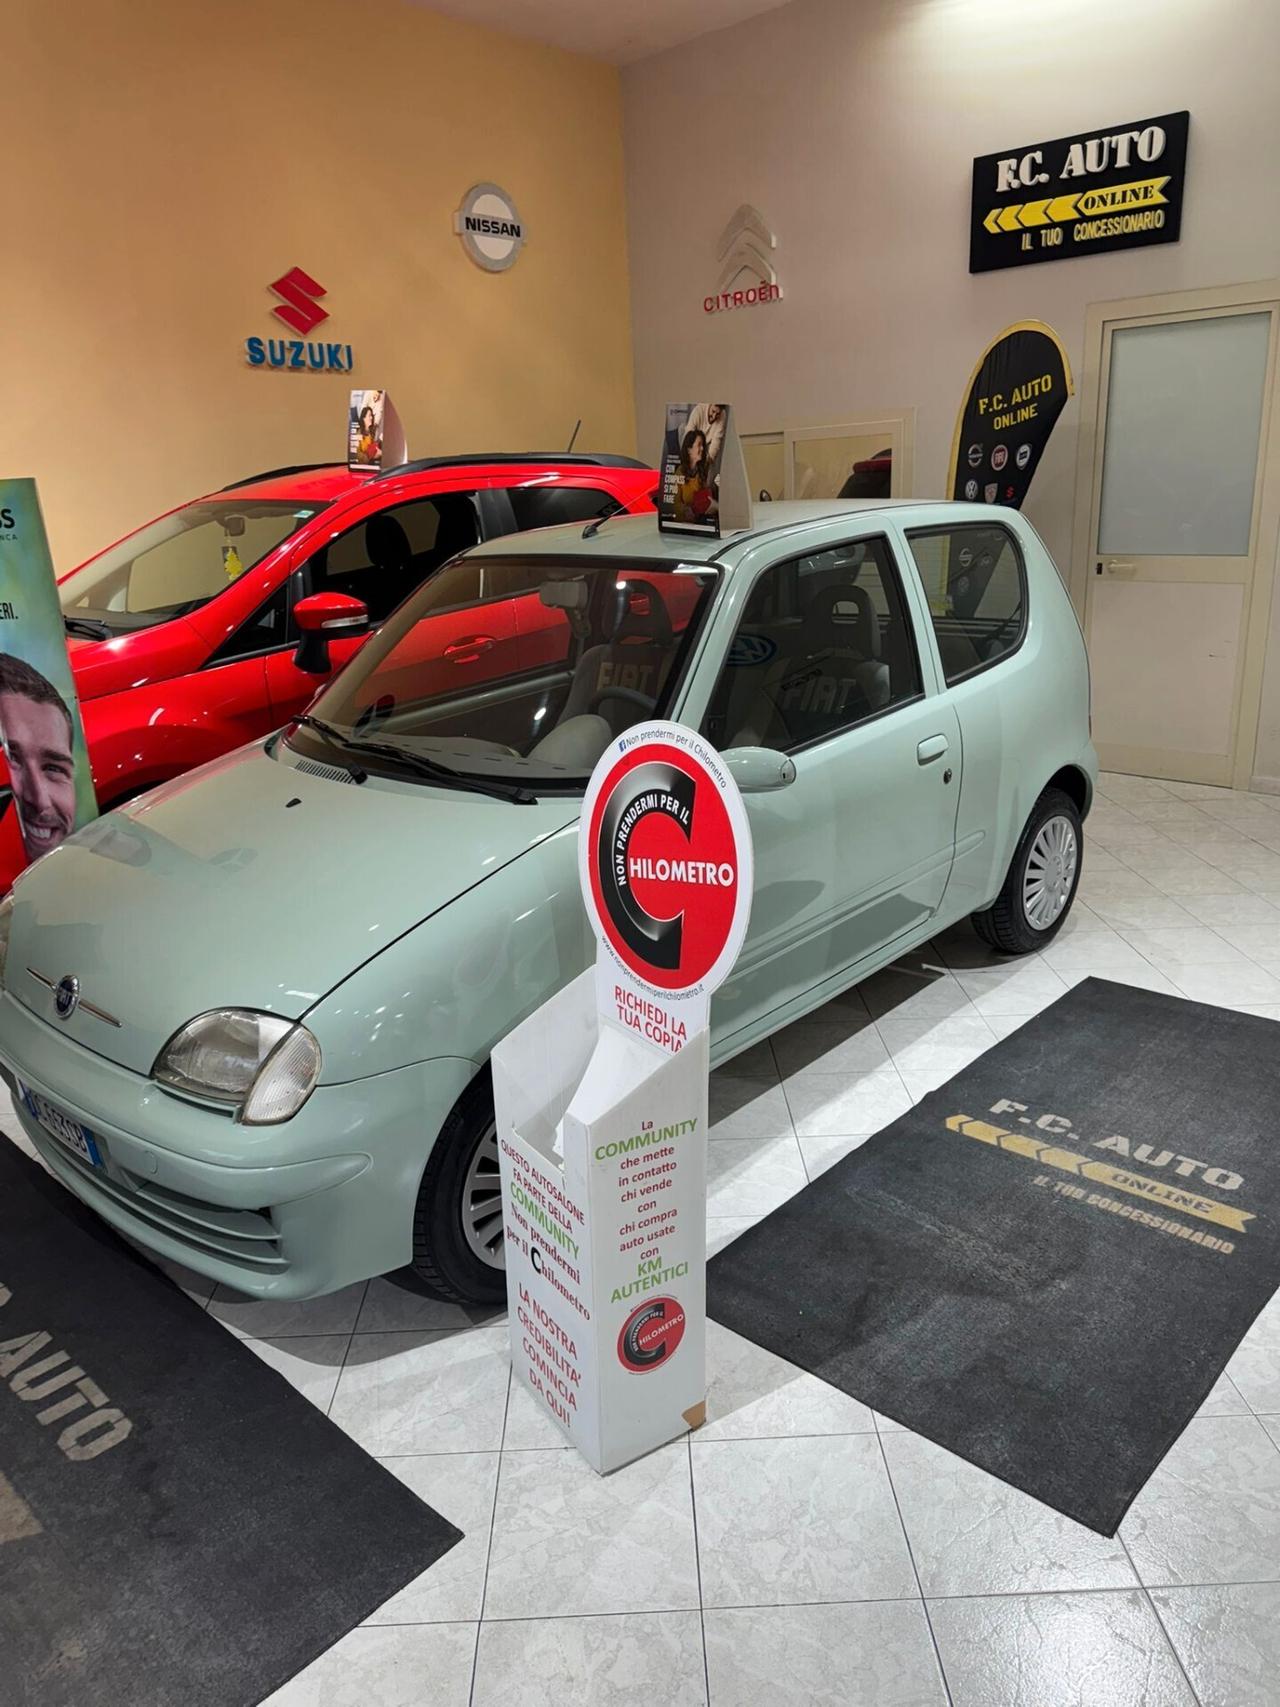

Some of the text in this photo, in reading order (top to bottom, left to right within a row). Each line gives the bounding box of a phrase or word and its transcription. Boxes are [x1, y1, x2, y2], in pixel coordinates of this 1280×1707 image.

[996, 126, 1166, 192] F.C. AUTO
[1084, 185, 1154, 210] ONLINE
[464, 216, 521, 238] NISSAN
[1021, 209, 1165, 250] IL TUO CONCESSIONARIO
[247, 337, 353, 371] SUZUKI
[978, 374, 1052, 415] F.C. AUTO
[993, 403, 1038, 430] ONLINE
[626, 728, 727, 789] Non prendermi per il Chilometro
[616, 793, 689, 886] NON PRENDERMI PER IL
[615, 984, 687, 1040] RICHIEDI LA
[616, 1004, 642, 1033] TUA
[595, 1118, 698, 1161] COMMUNITY
[641, 1120, 653, 1131] La
[989, 1098, 1245, 1190] F.C. AUTO
[618, 1161, 677, 1187] in contatto
[620, 1146, 675, 1170] che mette
[501, 1139, 585, 1225] QUESTO AUTOSALONE
[513, 1168, 573, 1233] FA PARTE DELLA
[621, 1178, 672, 1203] chi vende
[1111, 1173, 1217, 1214] ONLINE
[511, 1181, 579, 1260] COMMUNITY
[619, 1208, 678, 1236] chi compra
[637, 1200, 657, 1213] con
[1032, 1175, 1235, 1255] IL TUO CONCESSIONARIO
[511, 1201, 581, 1285] Non prendermi
[619, 1224, 676, 1252] auto usate
[640, 1246, 659, 1260] con
[506, 1225, 590, 1320] per il Chilometro
[611, 1261, 688, 1303] AUTENTICI
[637, 1256, 662, 1277] KM
[519, 1282, 577, 1360] LA NOSTRA
[518, 1306, 581, 1388] CREDIBILITA'
[523, 1337, 577, 1411] COMINCIA
[530, 1367, 570, 1428] DA QUI!
